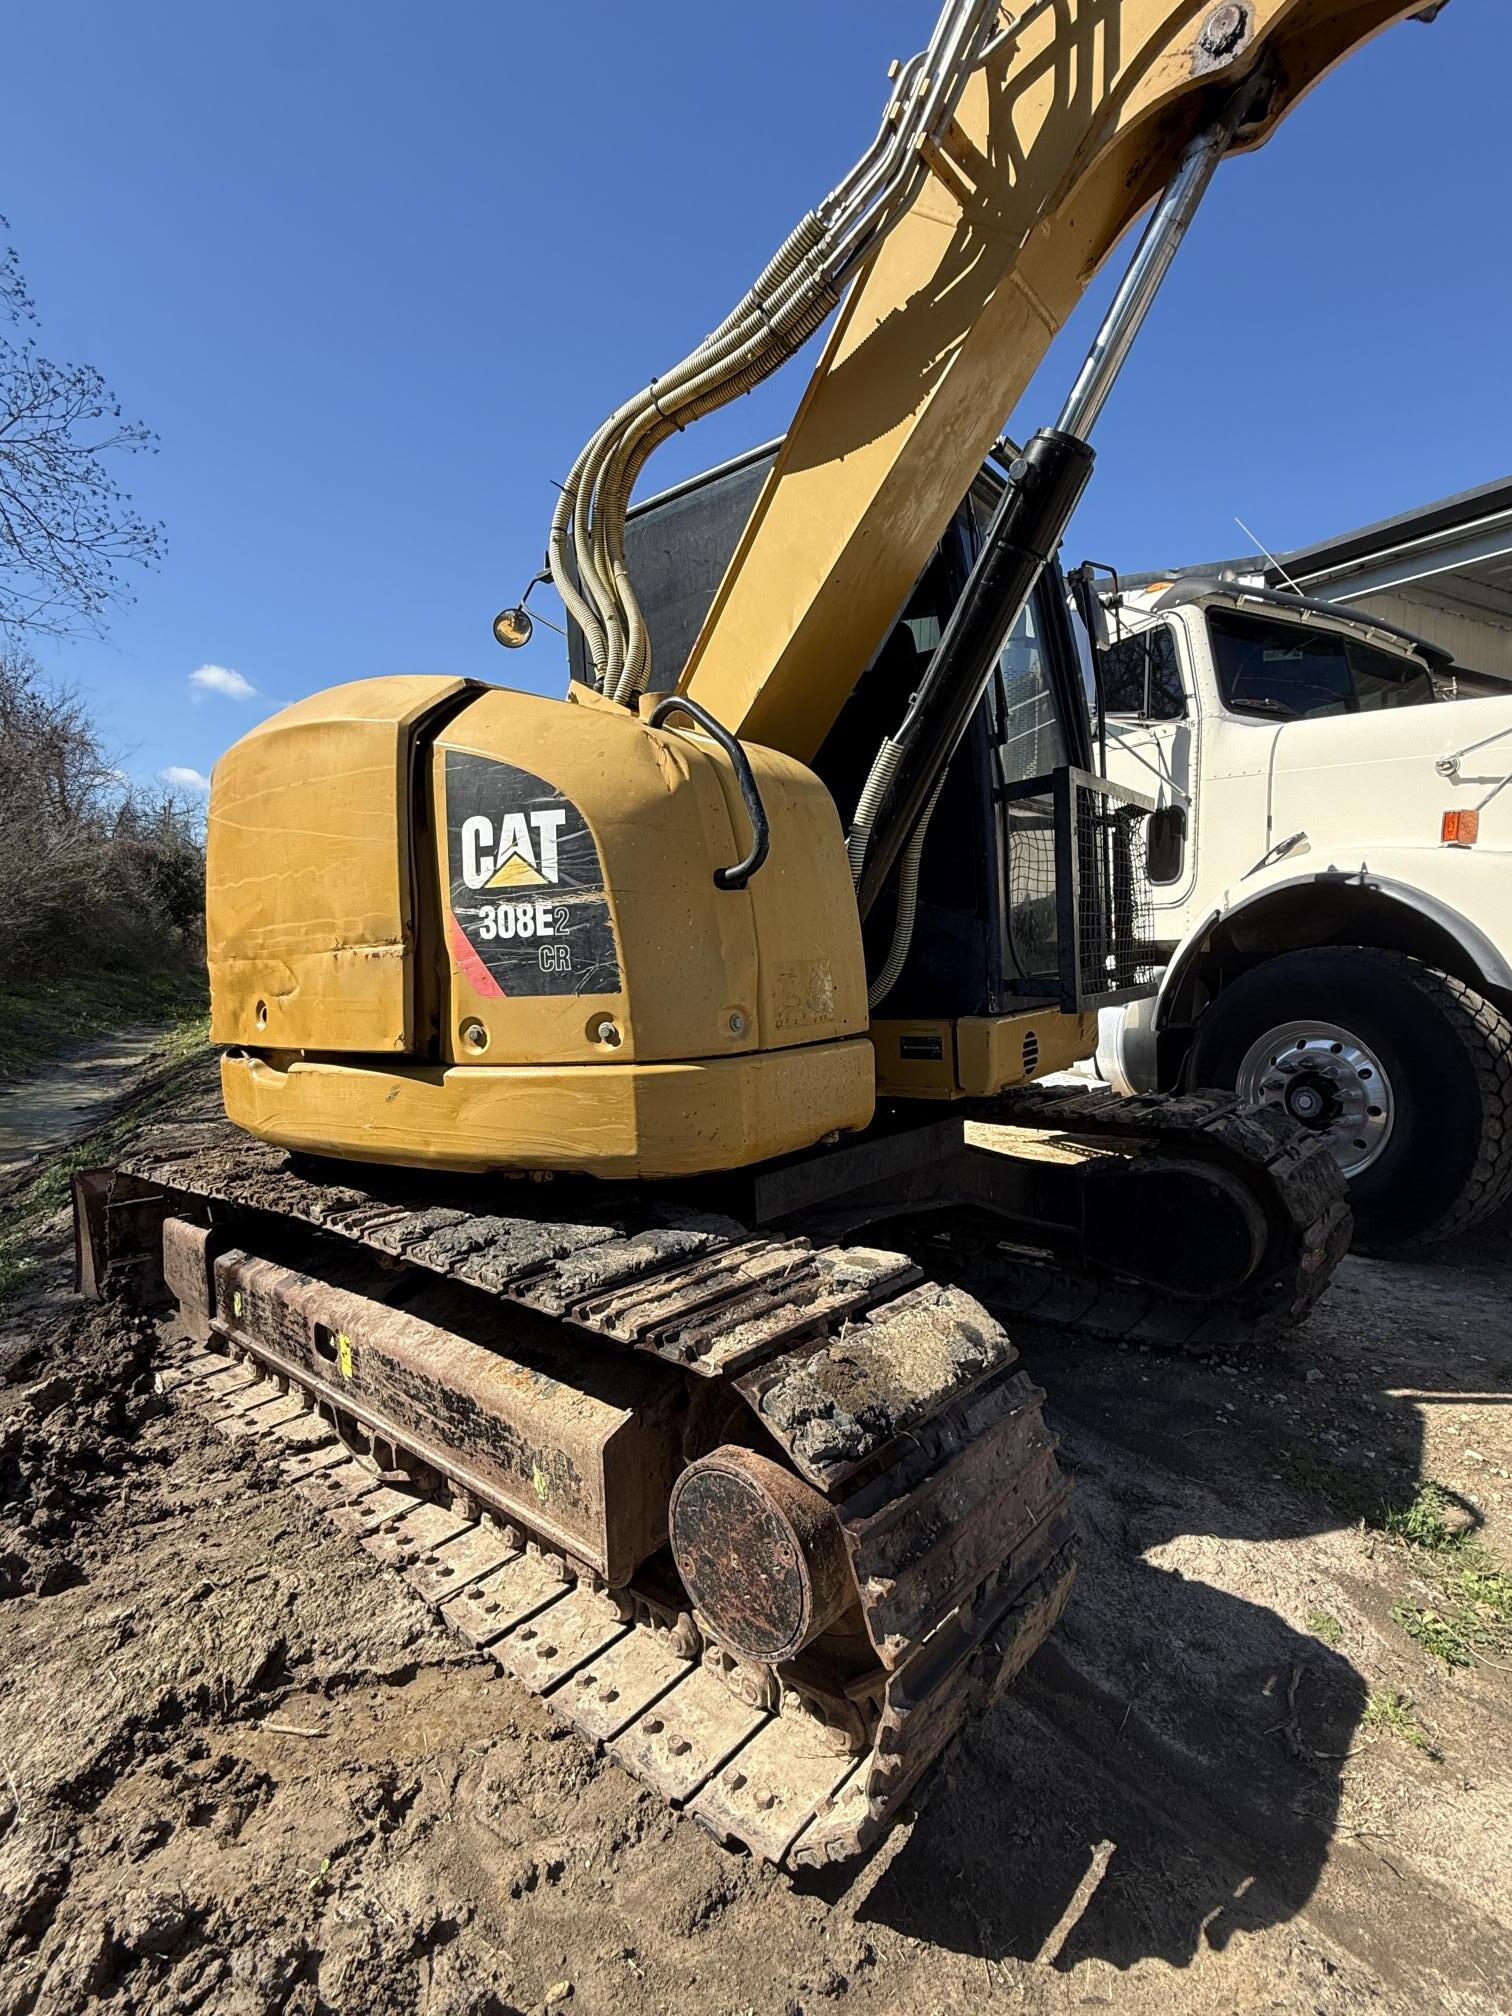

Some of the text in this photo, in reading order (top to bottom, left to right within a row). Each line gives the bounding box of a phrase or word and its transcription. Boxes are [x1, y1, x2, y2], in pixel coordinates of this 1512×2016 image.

[461, 810, 566, 889] CAT
[479, 905, 570, 939] 308E2
[538, 945, 571, 972] CR
